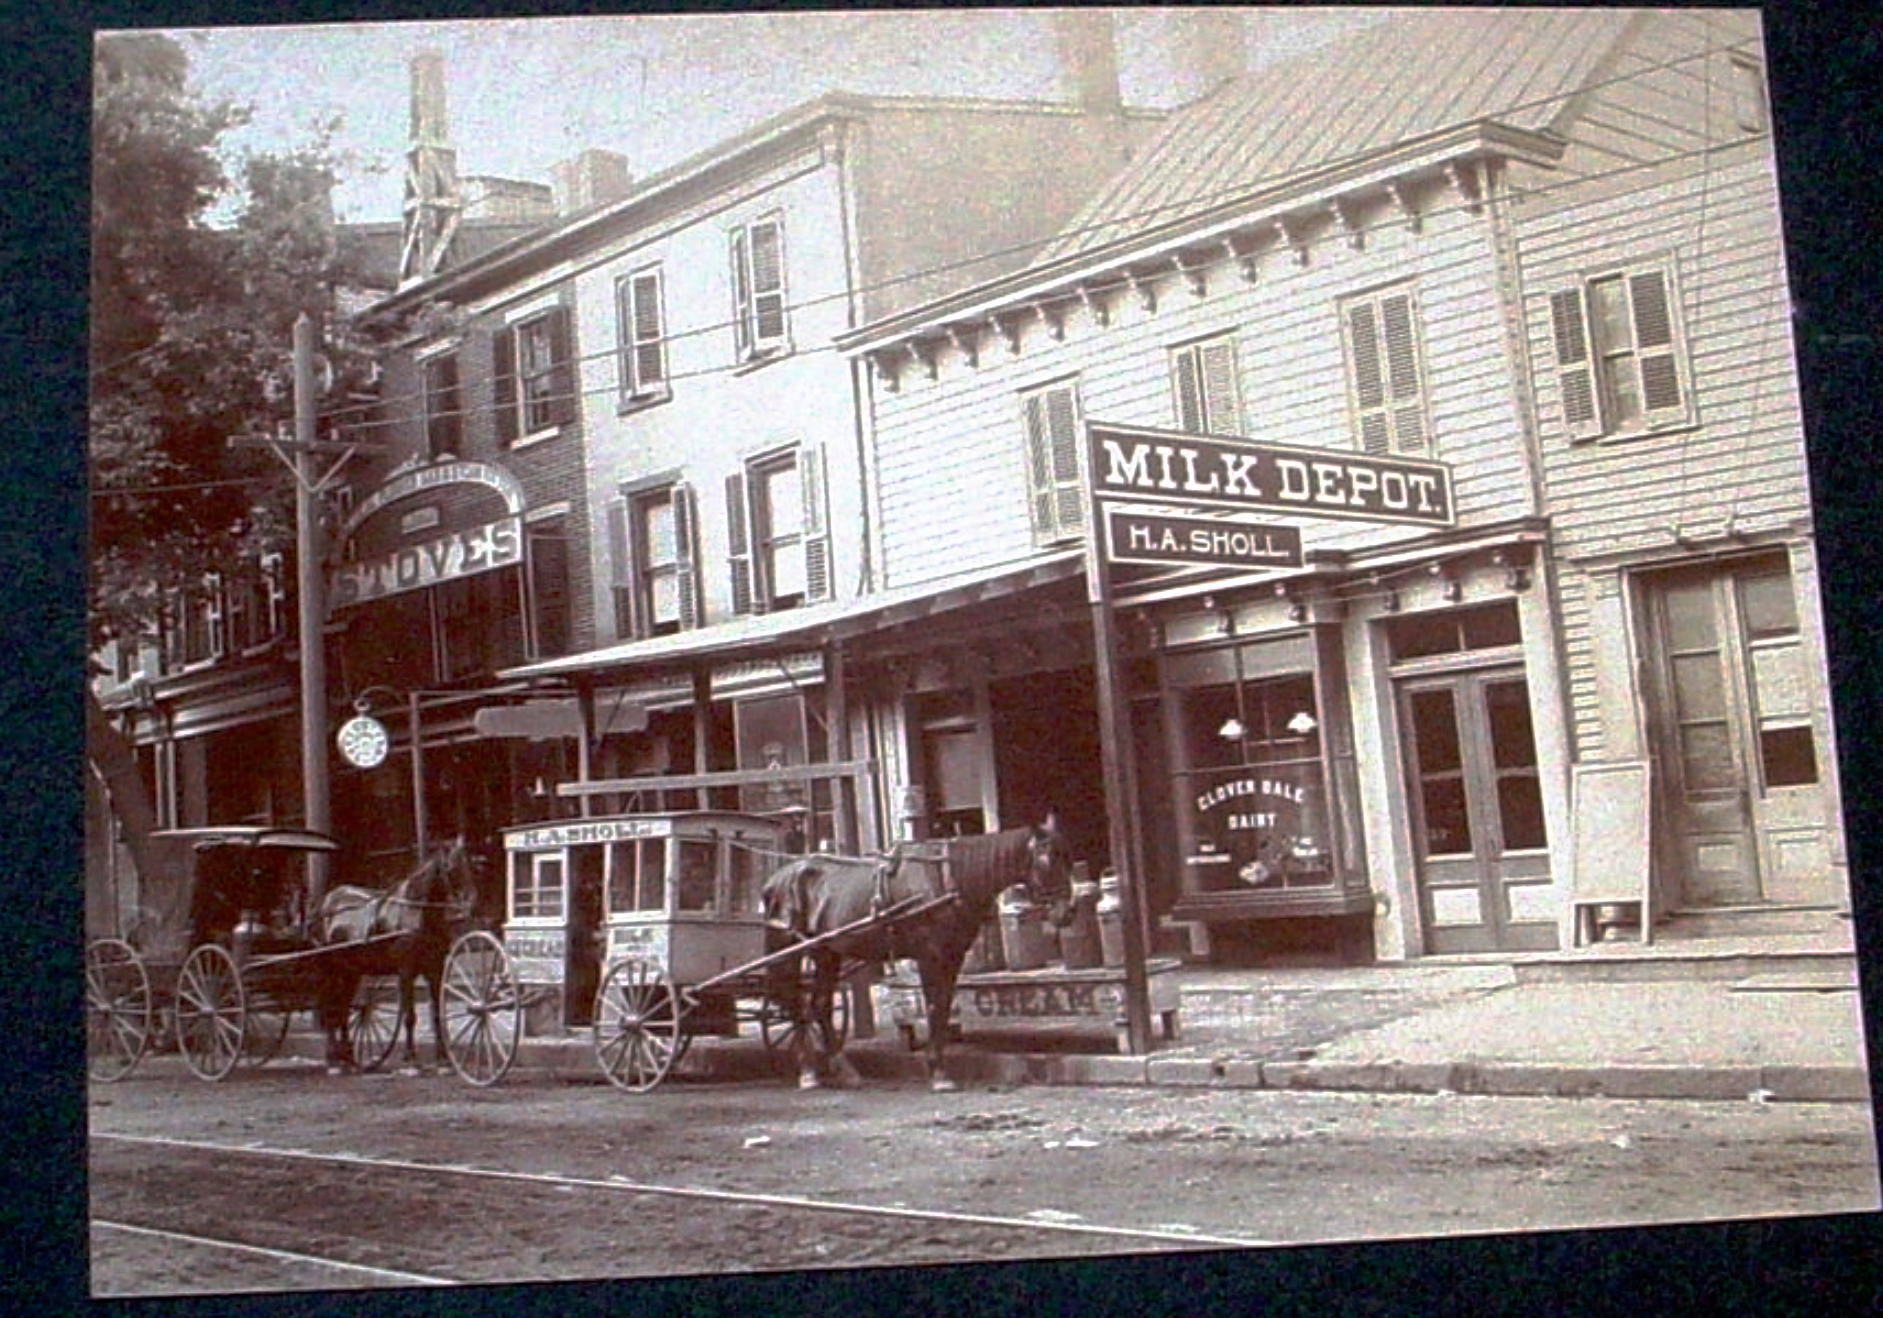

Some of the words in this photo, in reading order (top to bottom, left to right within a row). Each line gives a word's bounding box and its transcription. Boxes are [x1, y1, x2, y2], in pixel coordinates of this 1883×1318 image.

[1102, 439, 1262, 498] MILK
[1276, 458, 1442, 513] DEPOT.
[1190, 528, 1290, 558] SHOLL.
[1197, 780, 1256, 811] CLOVER
[1261, 780, 1306, 804] DALE
